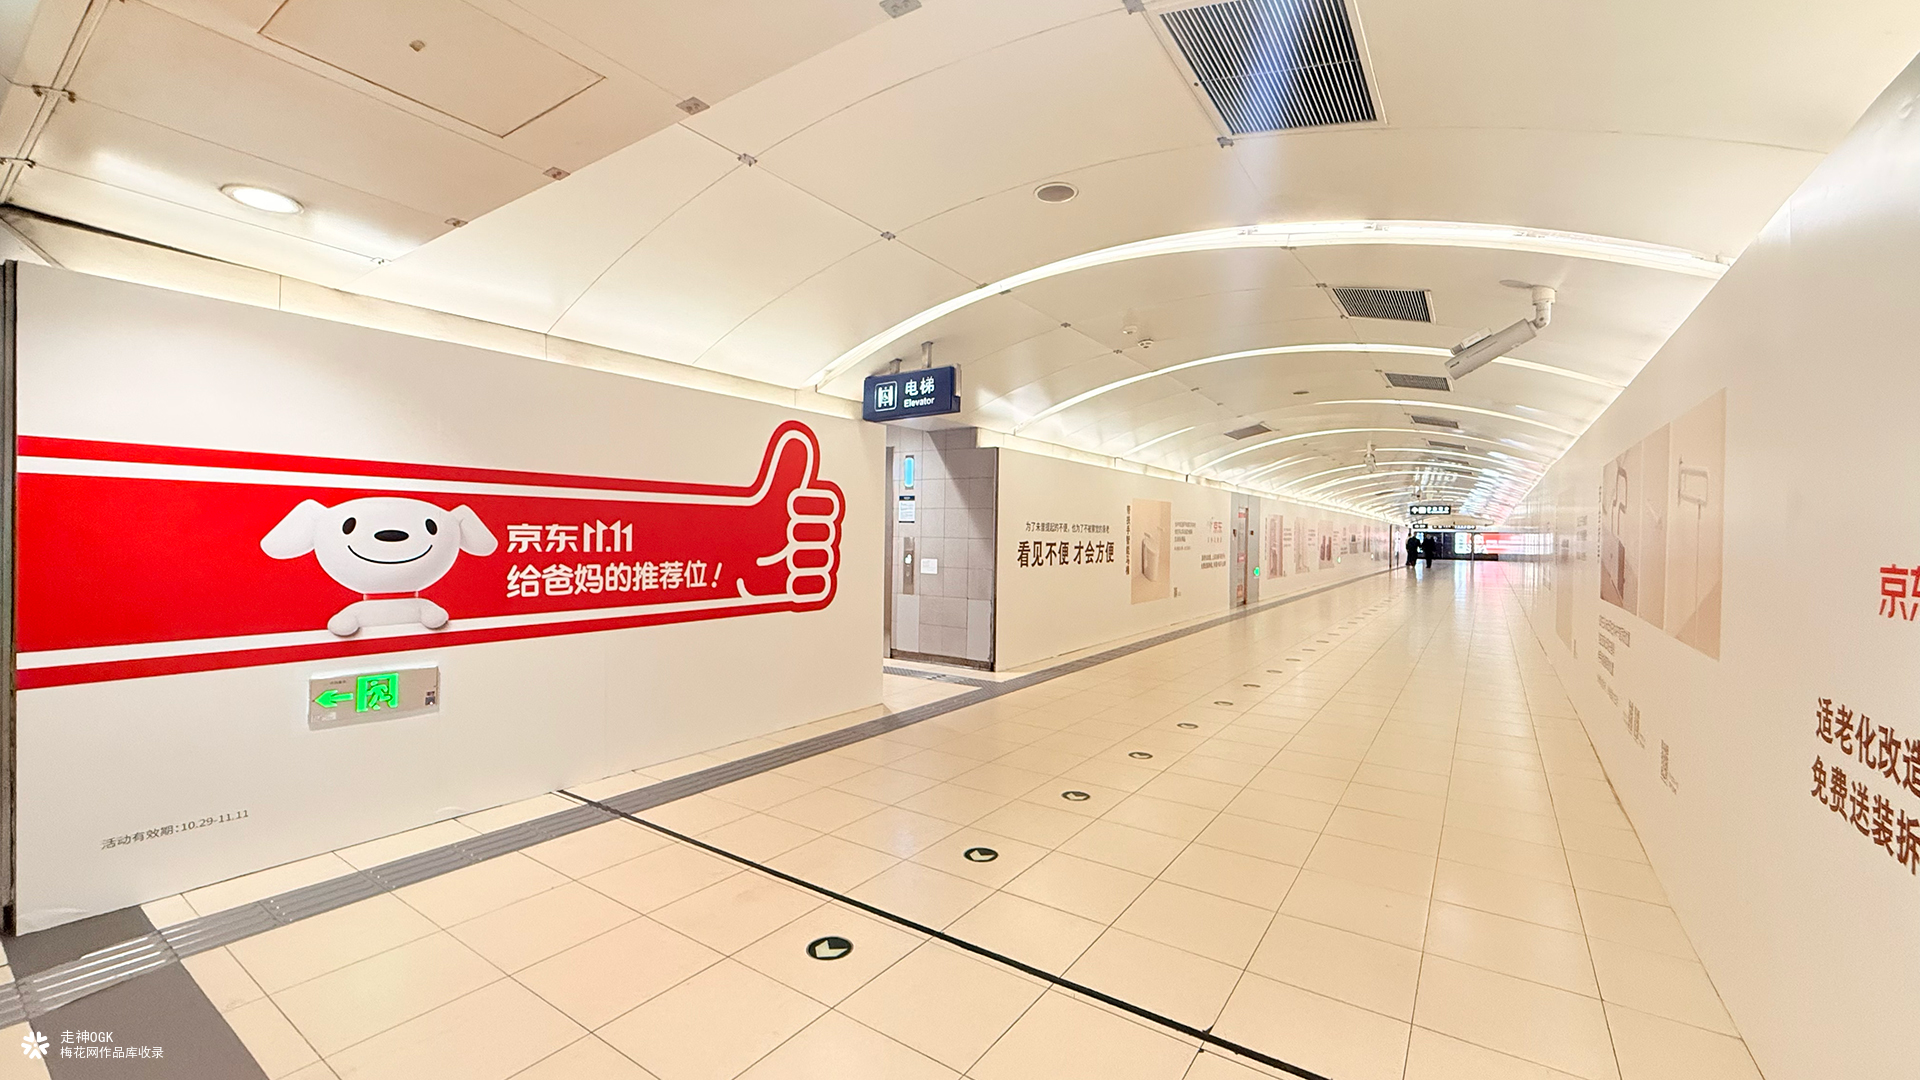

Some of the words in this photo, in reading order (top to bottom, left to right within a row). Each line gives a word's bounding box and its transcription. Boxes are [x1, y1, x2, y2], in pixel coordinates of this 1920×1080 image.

[903, 396, 936, 409] Elevator
[904, 376, 936, 397] 电梯
[1017, 540, 1070, 568] 看见不便
[1072, 540, 1115, 565] 才会方便
[506, 559, 723, 599] 给爸妈的推荐位！
[1815, 696, 1920, 799] 适老化改造
[1810, 754, 1920, 876] 免费送装拆
